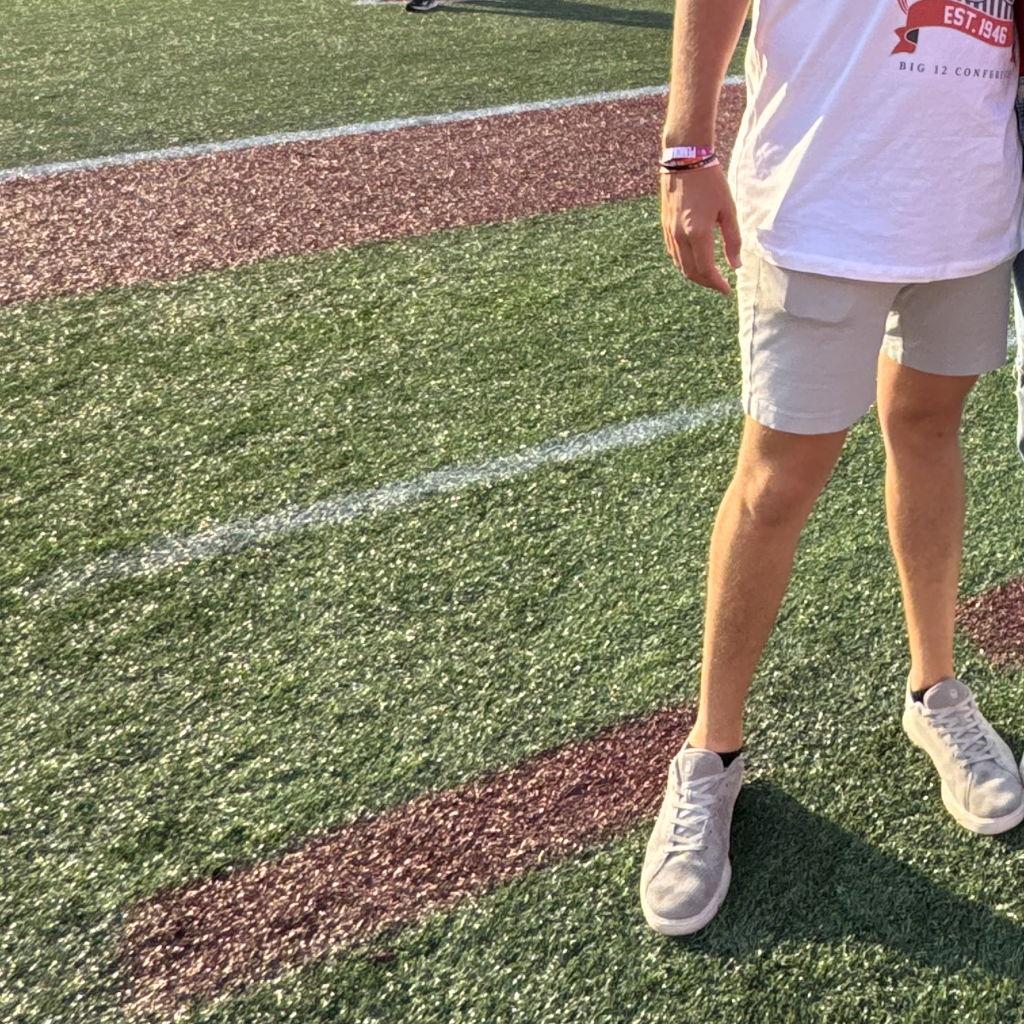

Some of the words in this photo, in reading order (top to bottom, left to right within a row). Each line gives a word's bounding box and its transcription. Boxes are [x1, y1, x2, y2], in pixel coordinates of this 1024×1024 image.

[943, 4, 976, 34] EST.
[979, 20, 1008, 45] 1946
[899, 61, 925, 73] BIG
[934, 64, 948, 76] 12
